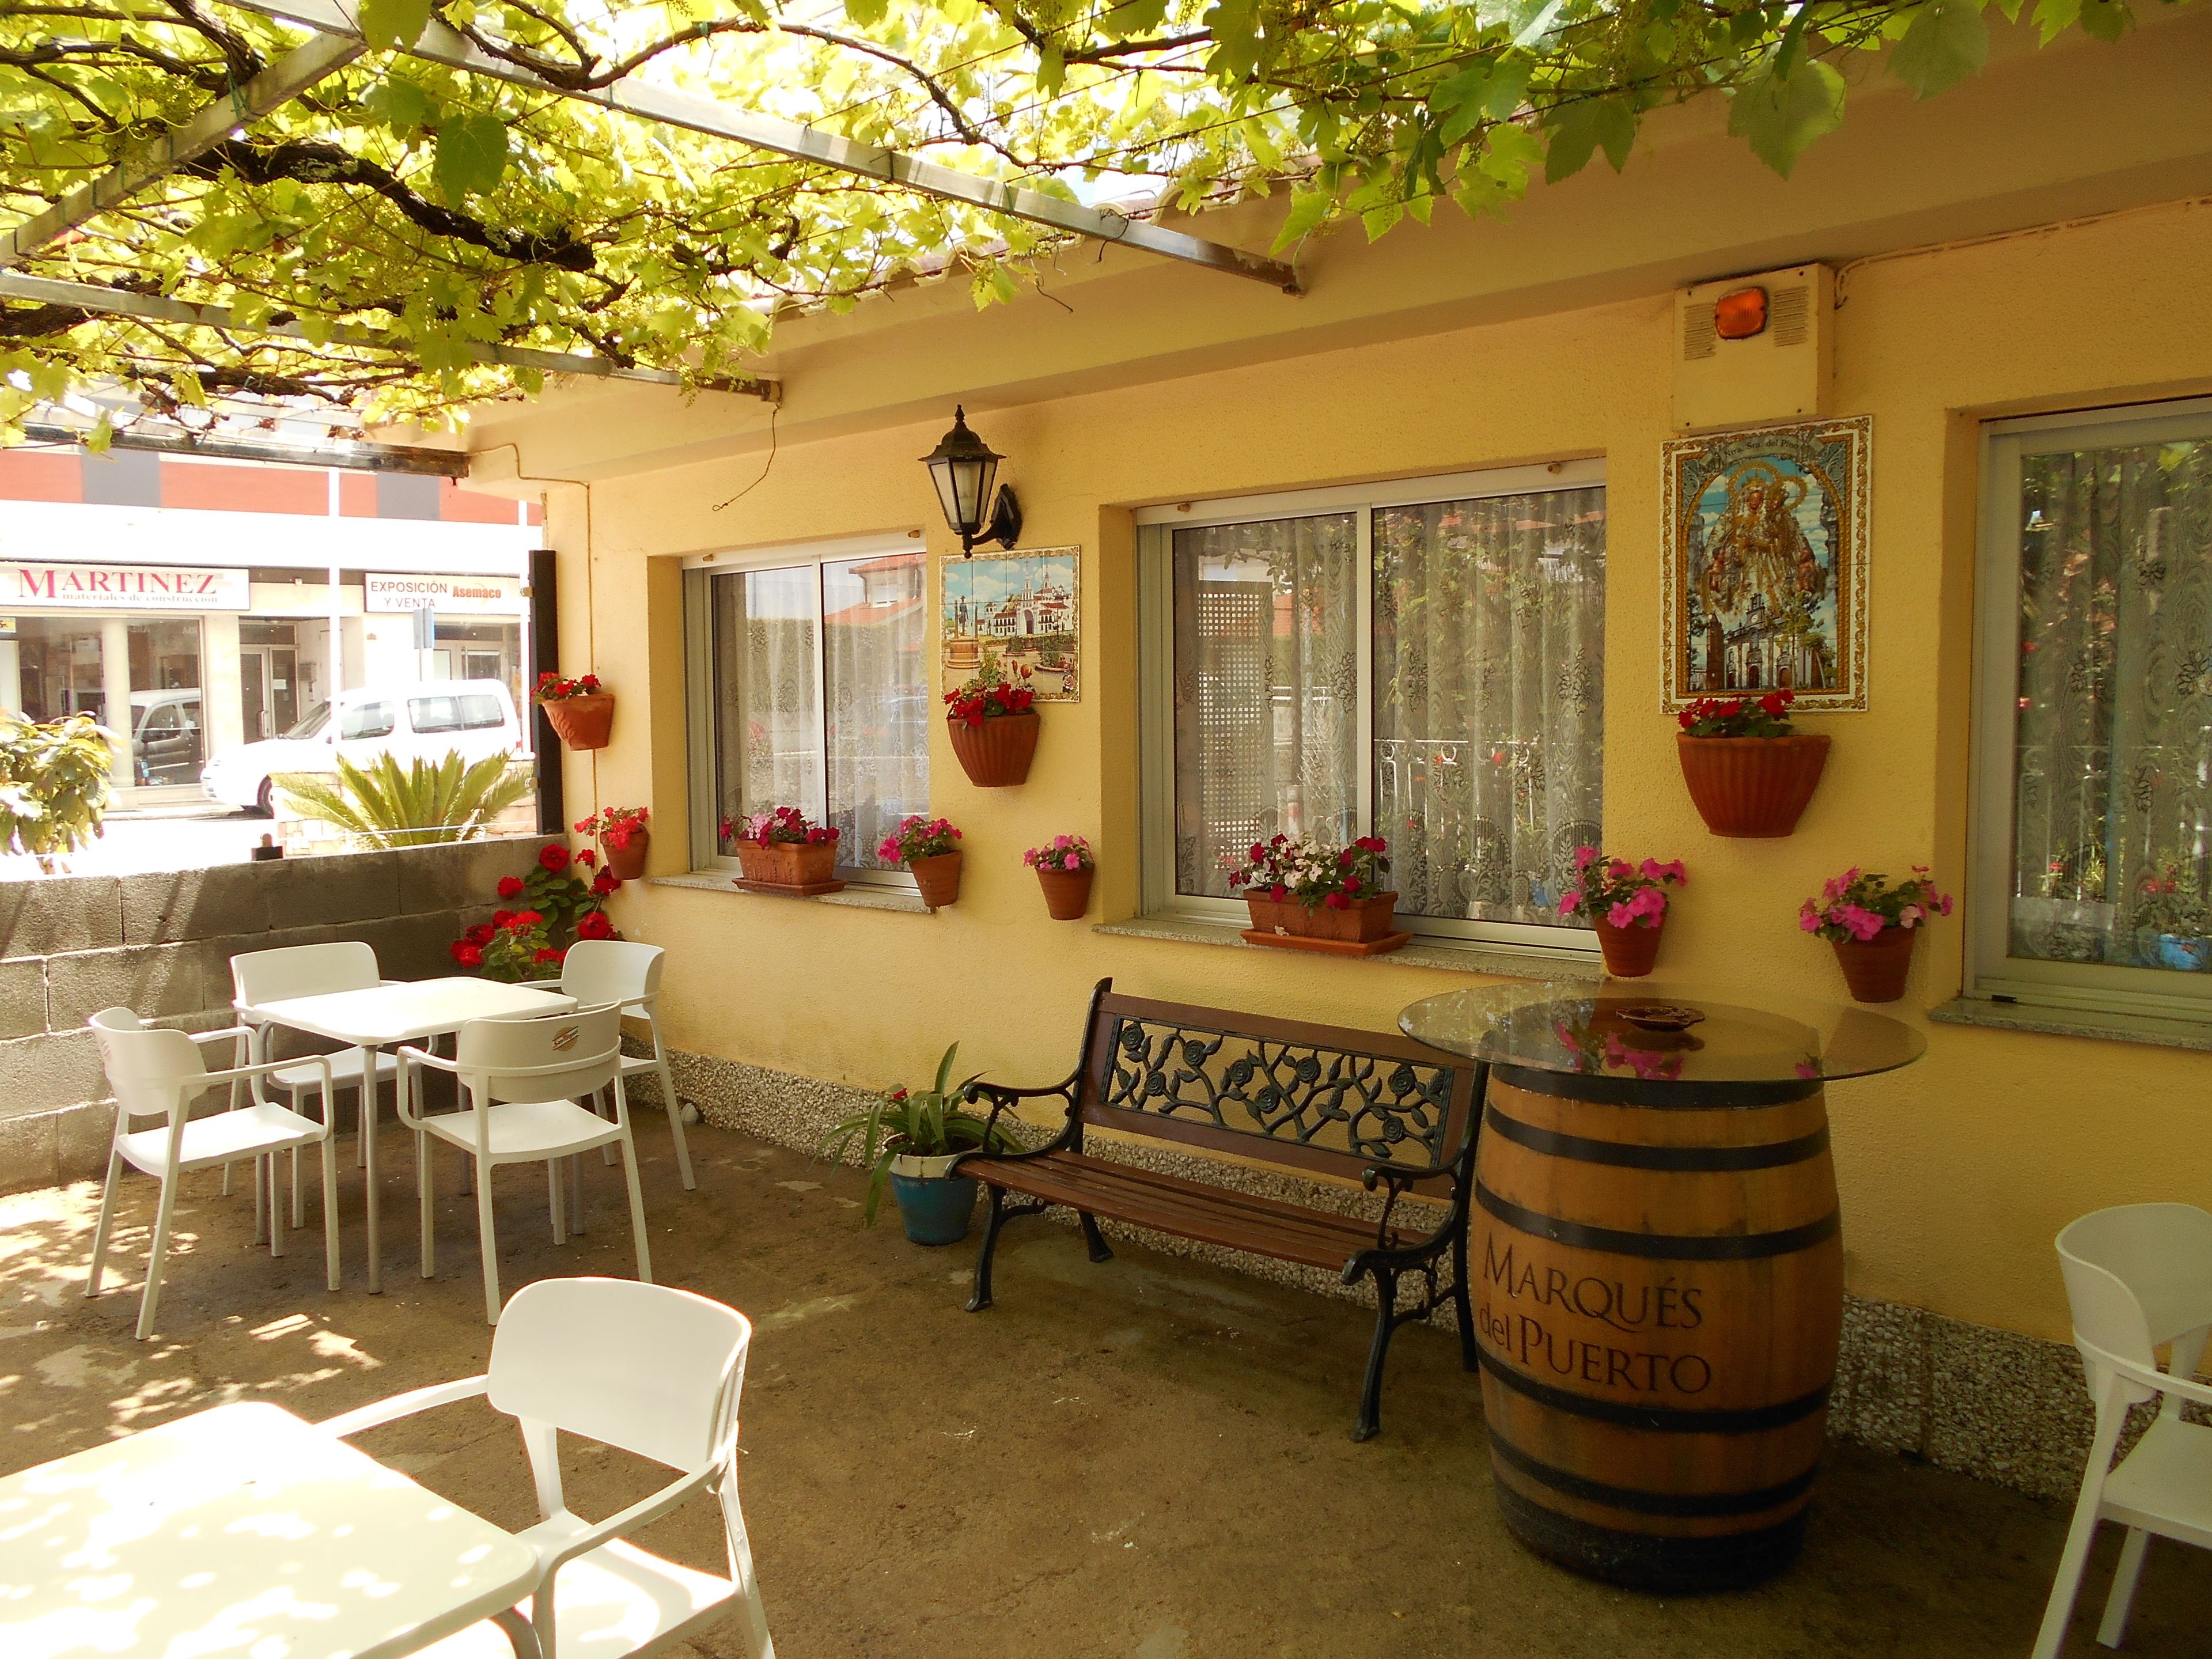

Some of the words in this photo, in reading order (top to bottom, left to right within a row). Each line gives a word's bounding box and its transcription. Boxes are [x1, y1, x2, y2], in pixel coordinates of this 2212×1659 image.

[1746, 441, 1763, 449] Sra.
[1766, 439, 1778, 447] del
[1780, 439, 1799, 449] Pino
[18, 569, 217, 598] MARTINEZ
[370, 580, 448, 593] EXPOSICIÓN
[62, 593, 125, 601] materiales
[452, 585, 502, 599] Asemaco
[384, 597, 391, 607] Y
[396, 597, 436, 608] VENTA
[1483, 1232, 1703, 1334] MARQUÉS
[1479, 1302, 1513, 1352] del
[1518, 1313, 1711, 1394] PUERTO
